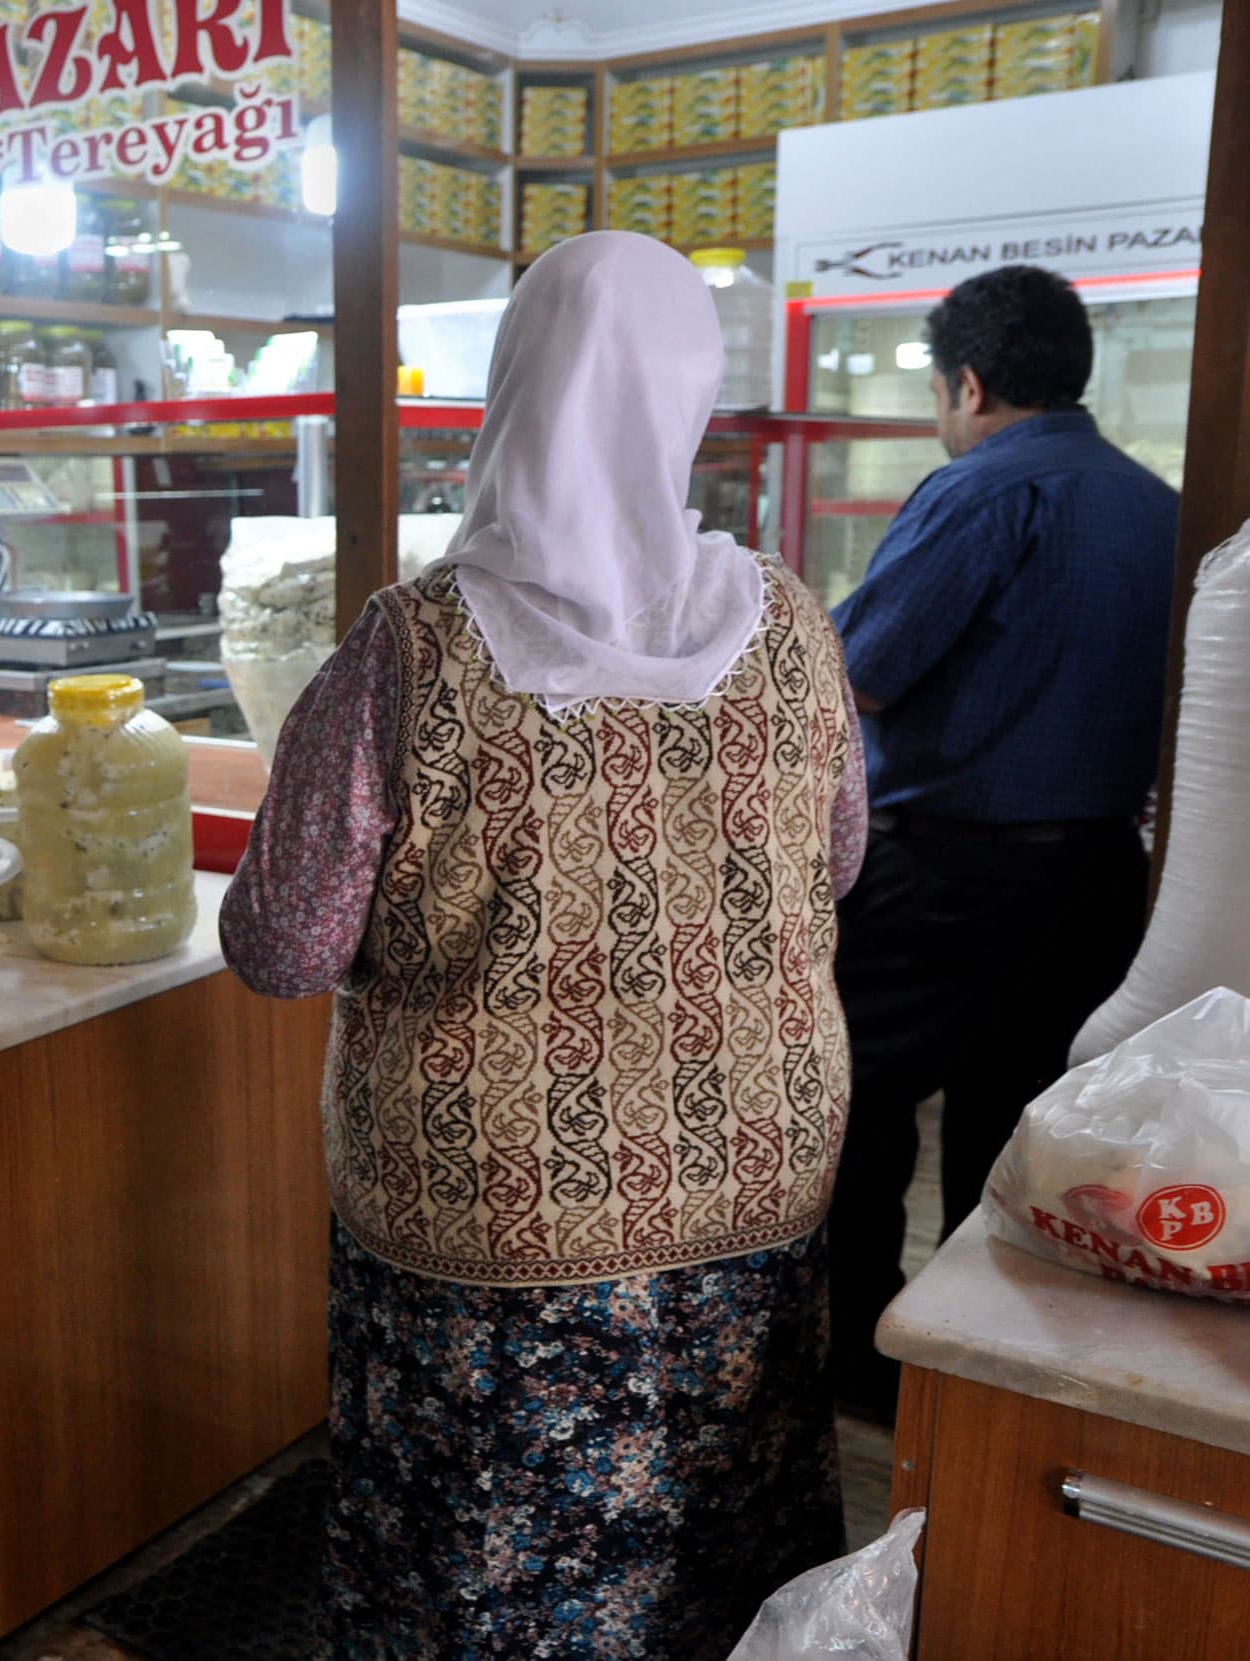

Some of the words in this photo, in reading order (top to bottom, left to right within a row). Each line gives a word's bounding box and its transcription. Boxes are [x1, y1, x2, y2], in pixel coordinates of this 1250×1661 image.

[7, 84, 298, 184] Tereyağı
[887, 245, 991, 270] KENAN
[1000, 233, 1098, 263] BESİN
[1107, 226, 1203, 252] PAZA
[1030, 1206, 1193, 1286] KENAN
